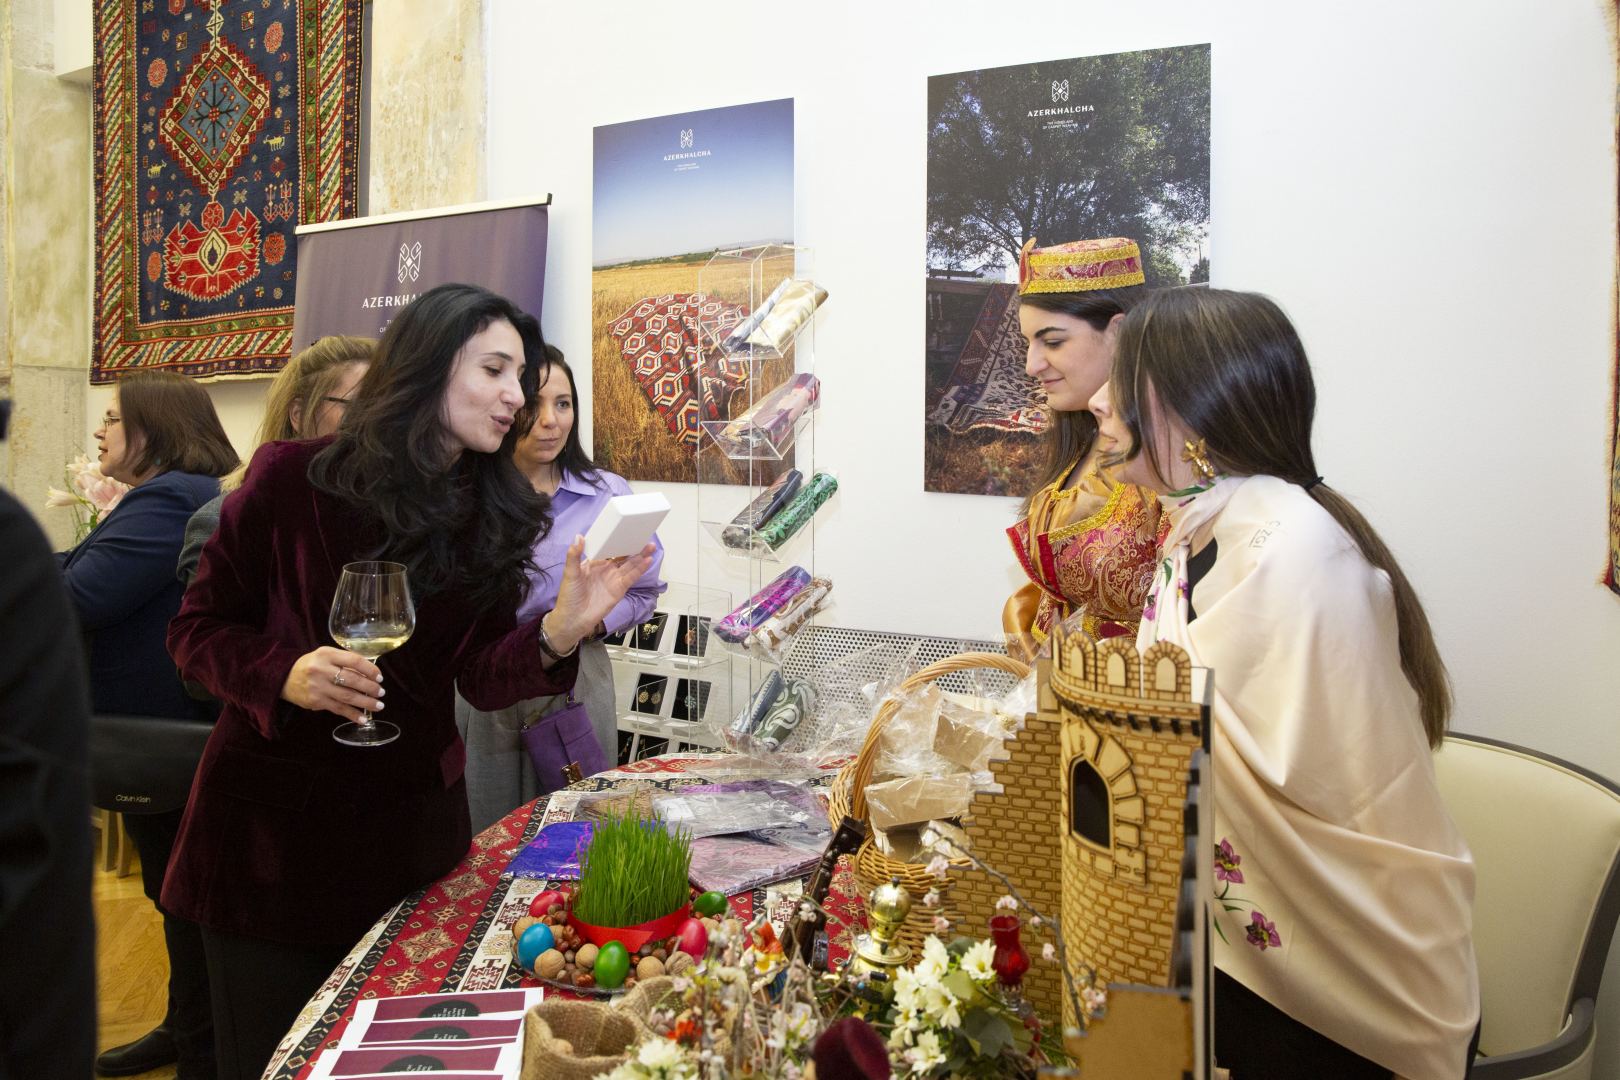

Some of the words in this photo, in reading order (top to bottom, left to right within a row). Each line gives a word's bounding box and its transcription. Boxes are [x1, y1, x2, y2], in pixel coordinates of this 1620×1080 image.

[1027, 105, 1095, 117] AZERKHALCHA
[362, 292, 422, 309] AZERKHA
[115, 794, 136, 802] Calvin
